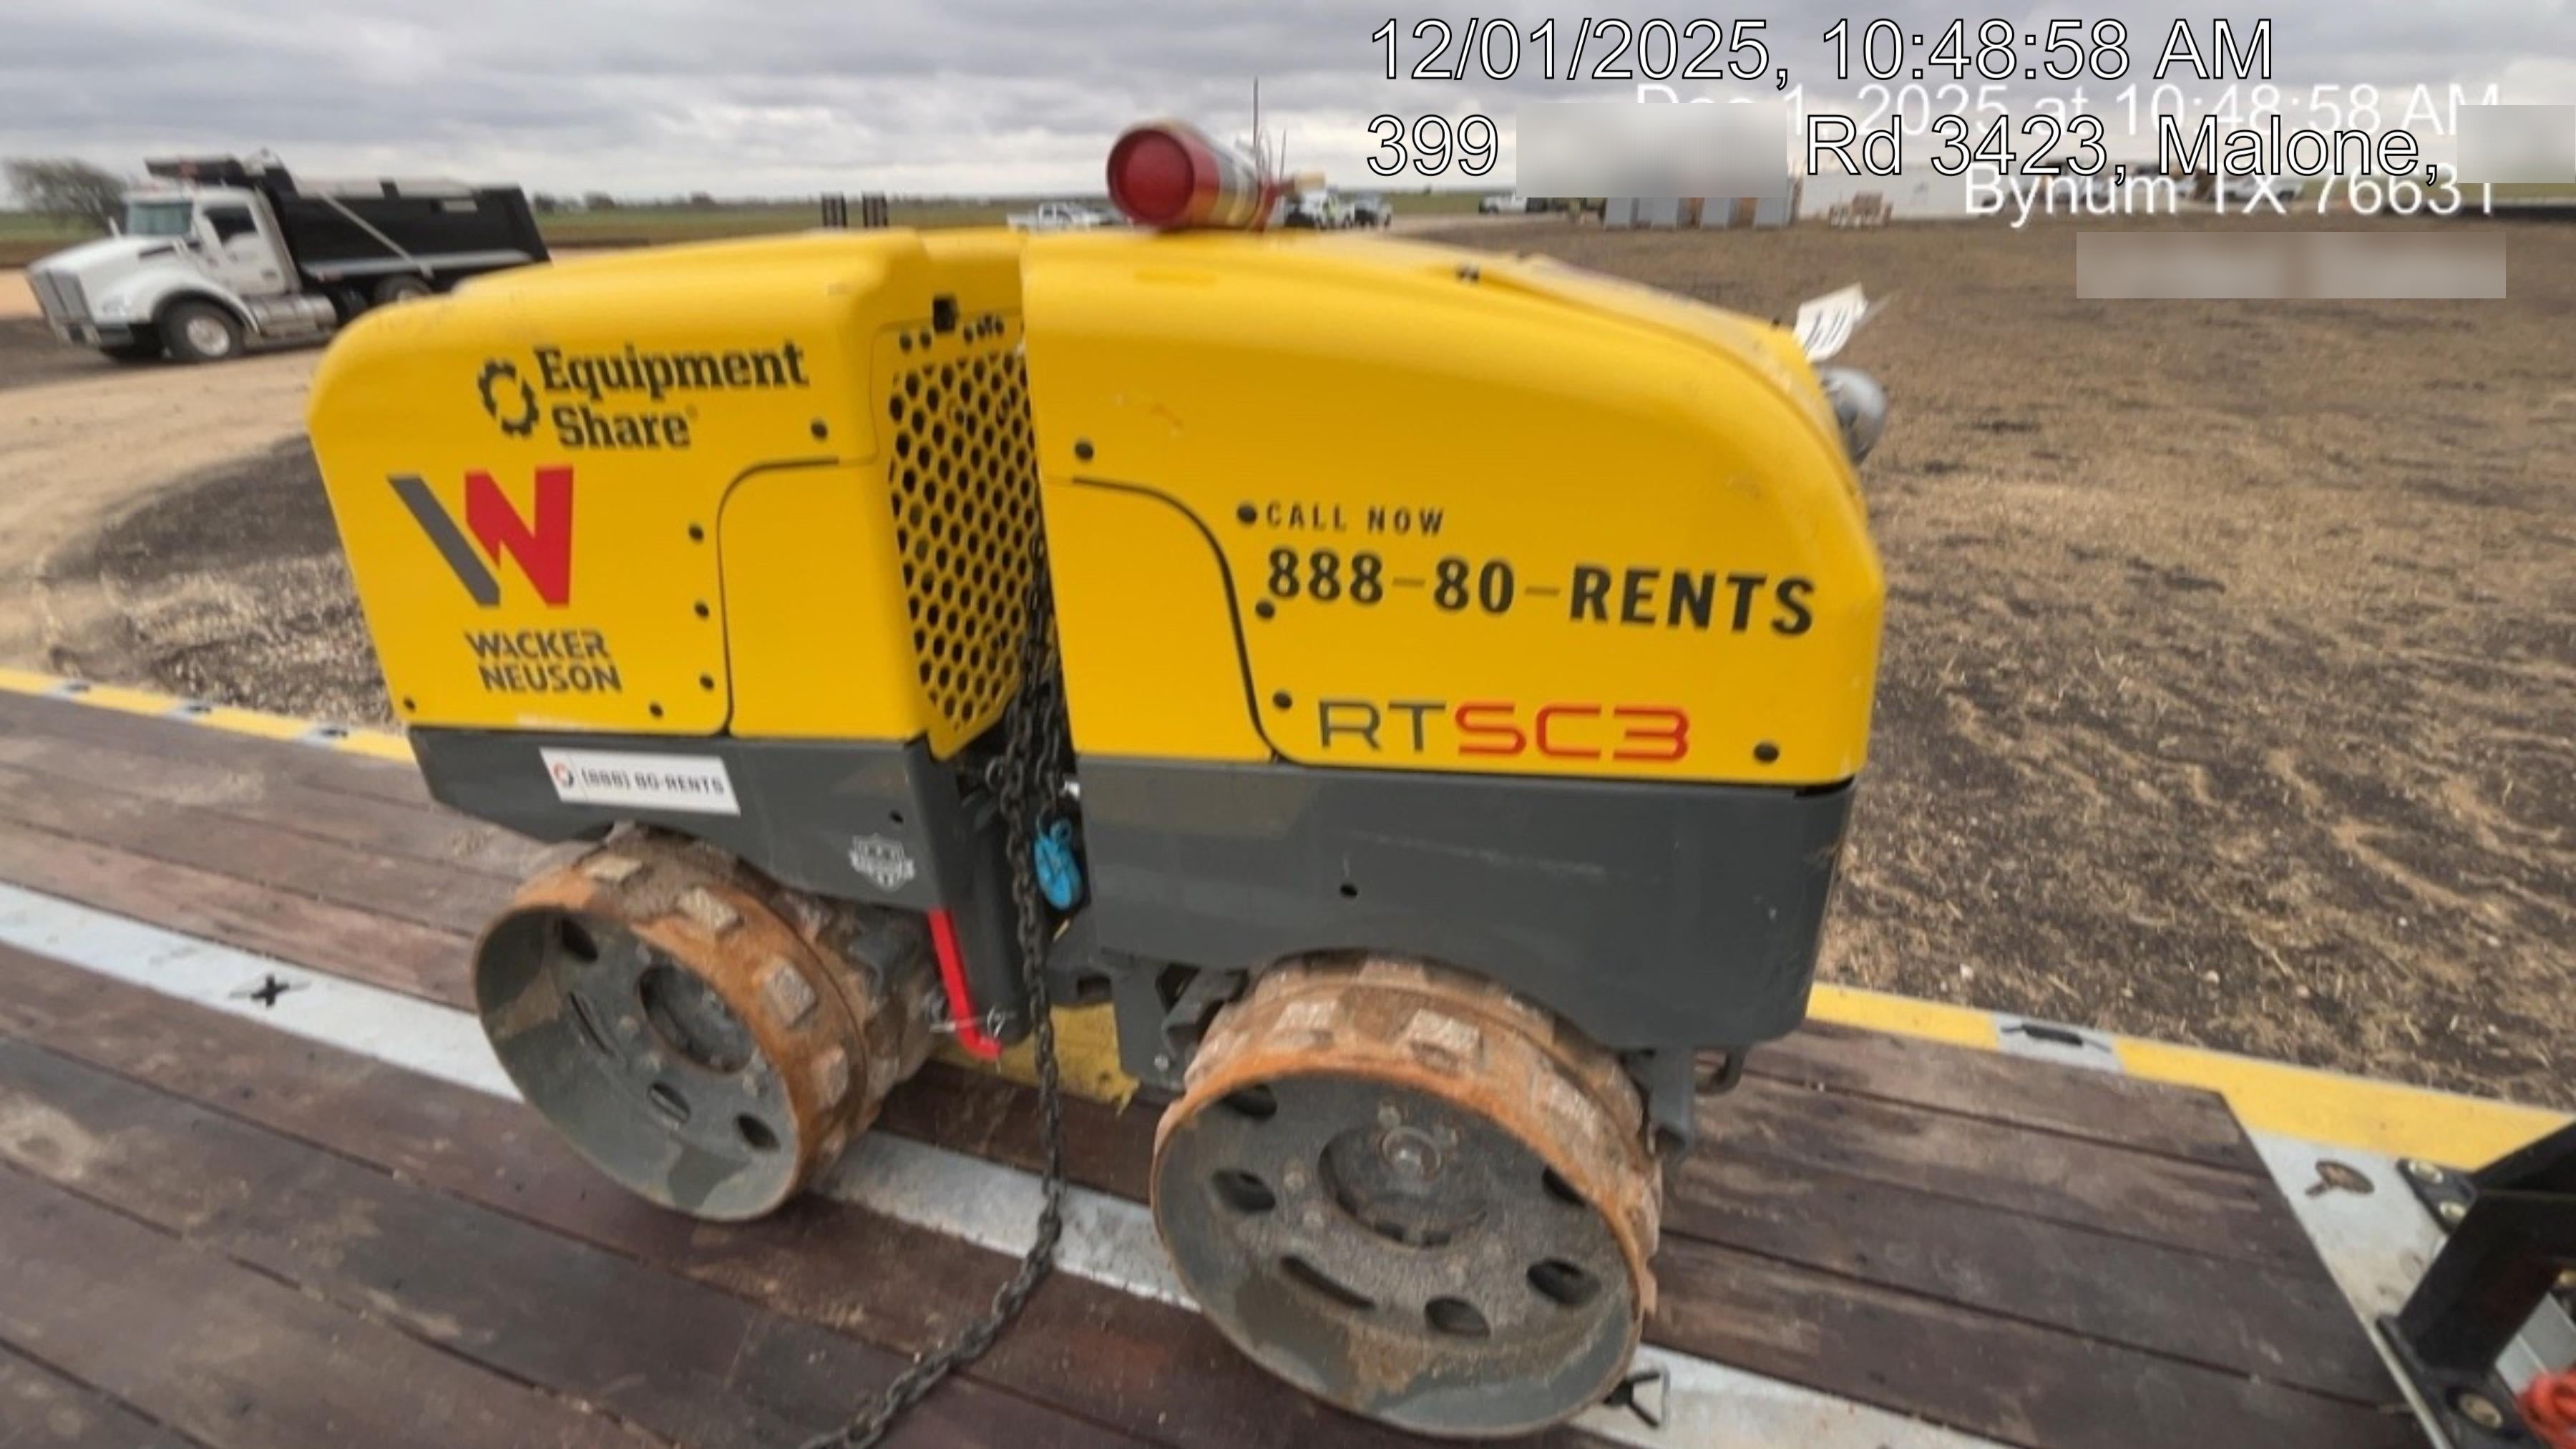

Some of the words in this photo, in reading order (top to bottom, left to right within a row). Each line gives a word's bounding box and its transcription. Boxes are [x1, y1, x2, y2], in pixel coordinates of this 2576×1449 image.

[535, 339, 809, 401] Equipment
[1266, 502, 1347, 532] CALL
[1367, 506, 1444, 536] NOW
[464, 628, 612, 659] WACKER
[479, 663, 623, 693] NEUSON
